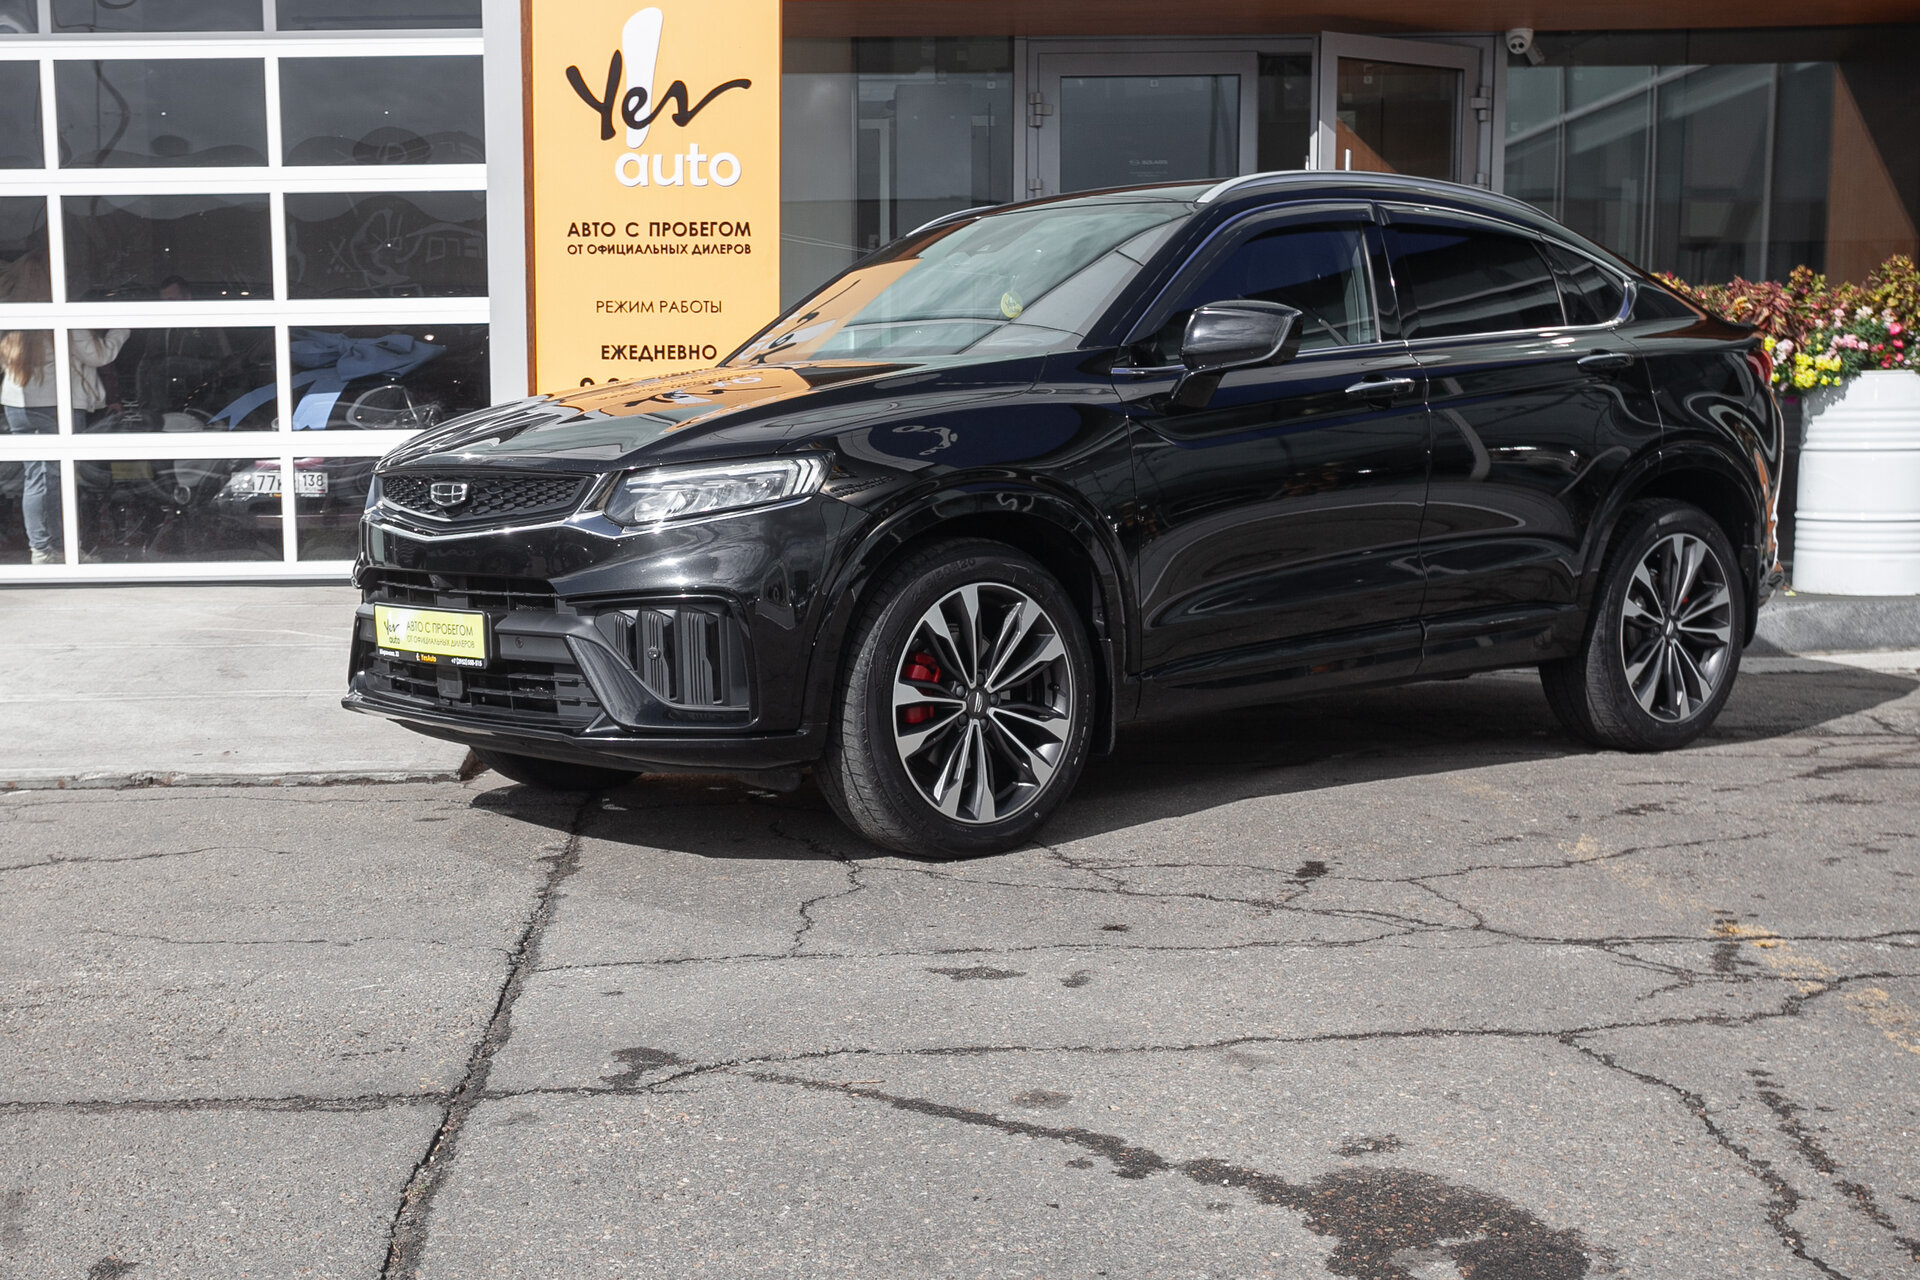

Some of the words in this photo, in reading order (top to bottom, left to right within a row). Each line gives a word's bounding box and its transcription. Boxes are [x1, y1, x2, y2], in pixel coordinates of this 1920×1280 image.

[566, 49, 752, 141] Yes
[615, 143, 742, 187] auto
[567, 221, 616, 238] АВТО
[625, 221, 640, 238] С
[649, 221, 752, 238] ПРОБЕГОМ
[567, 244, 583, 255] ОТ
[587, 243, 688, 256] ОФИЦИАЛЬНЫХ
[691, 243, 752, 256] ДИЛЕРОВ
[596, 300, 655, 314] РЕЖИМ
[659, 299, 722, 314] РАБОТЫ
[600, 344, 718, 362] ЕЖЕДНЕВНО
[302, 474, 325, 487] 138
[406, 621, 423, 633] АВТО
[424, 622, 431, 633] С
[432, 622, 474, 637] ПРОБЕГОМ
[389, 636, 401, 645] auto
